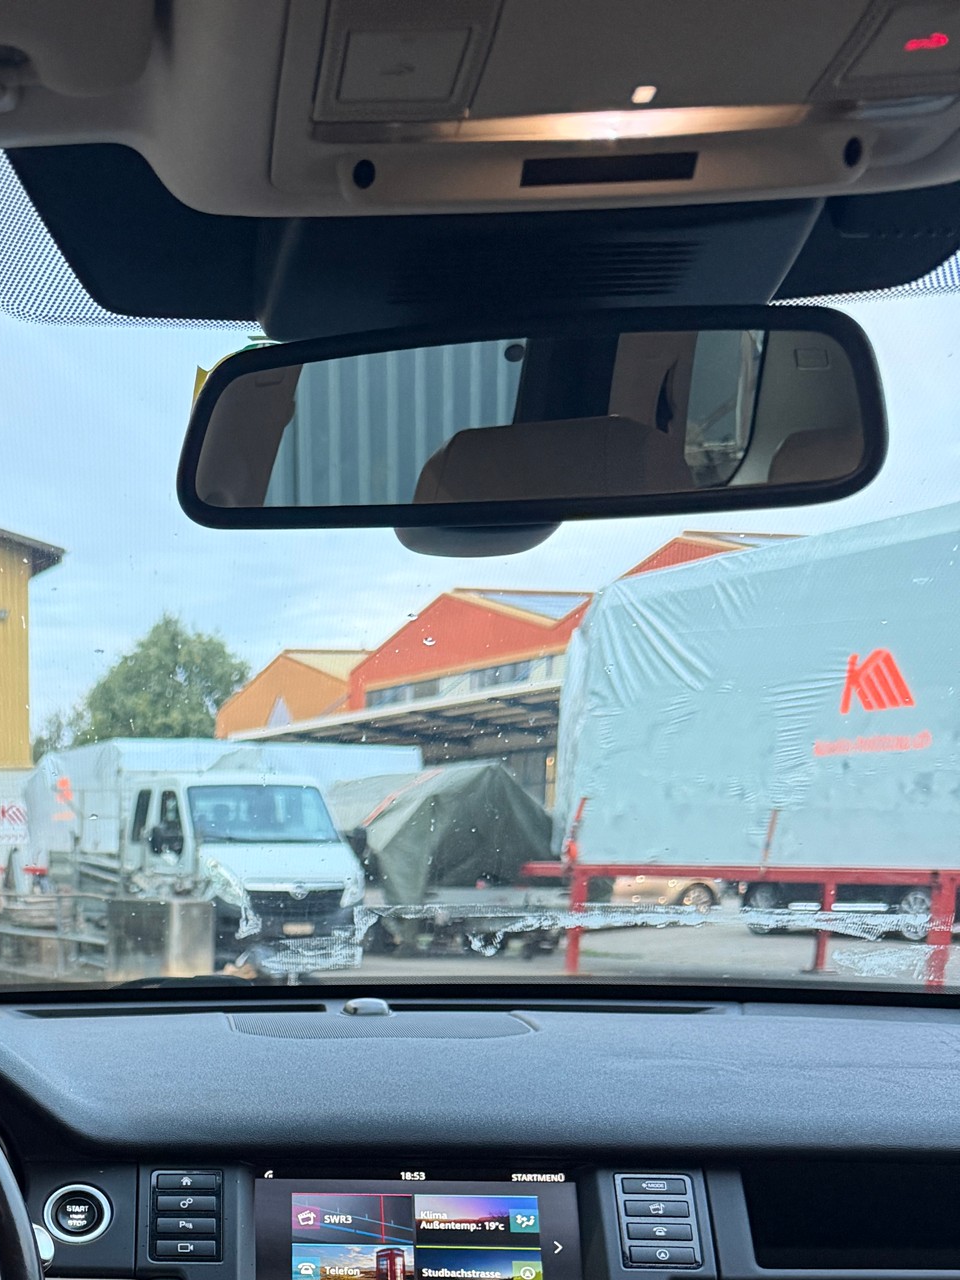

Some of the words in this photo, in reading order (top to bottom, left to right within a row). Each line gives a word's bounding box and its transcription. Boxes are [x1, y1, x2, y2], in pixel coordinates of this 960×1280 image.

[400, 1171, 426, 1181] 18:53
[511, 1172, 565, 1182] STARTMENÜ
[66, 1204, 89, 1212] START
[323, 1214, 353, 1225] SWR3
[419, 1210, 448, 1220] Klima
[419, 1220, 482, 1232] Außentemp.:
[324, 1265, 361, 1277] Telefon
[421, 1267, 502, 1279] Studbachstrasse
